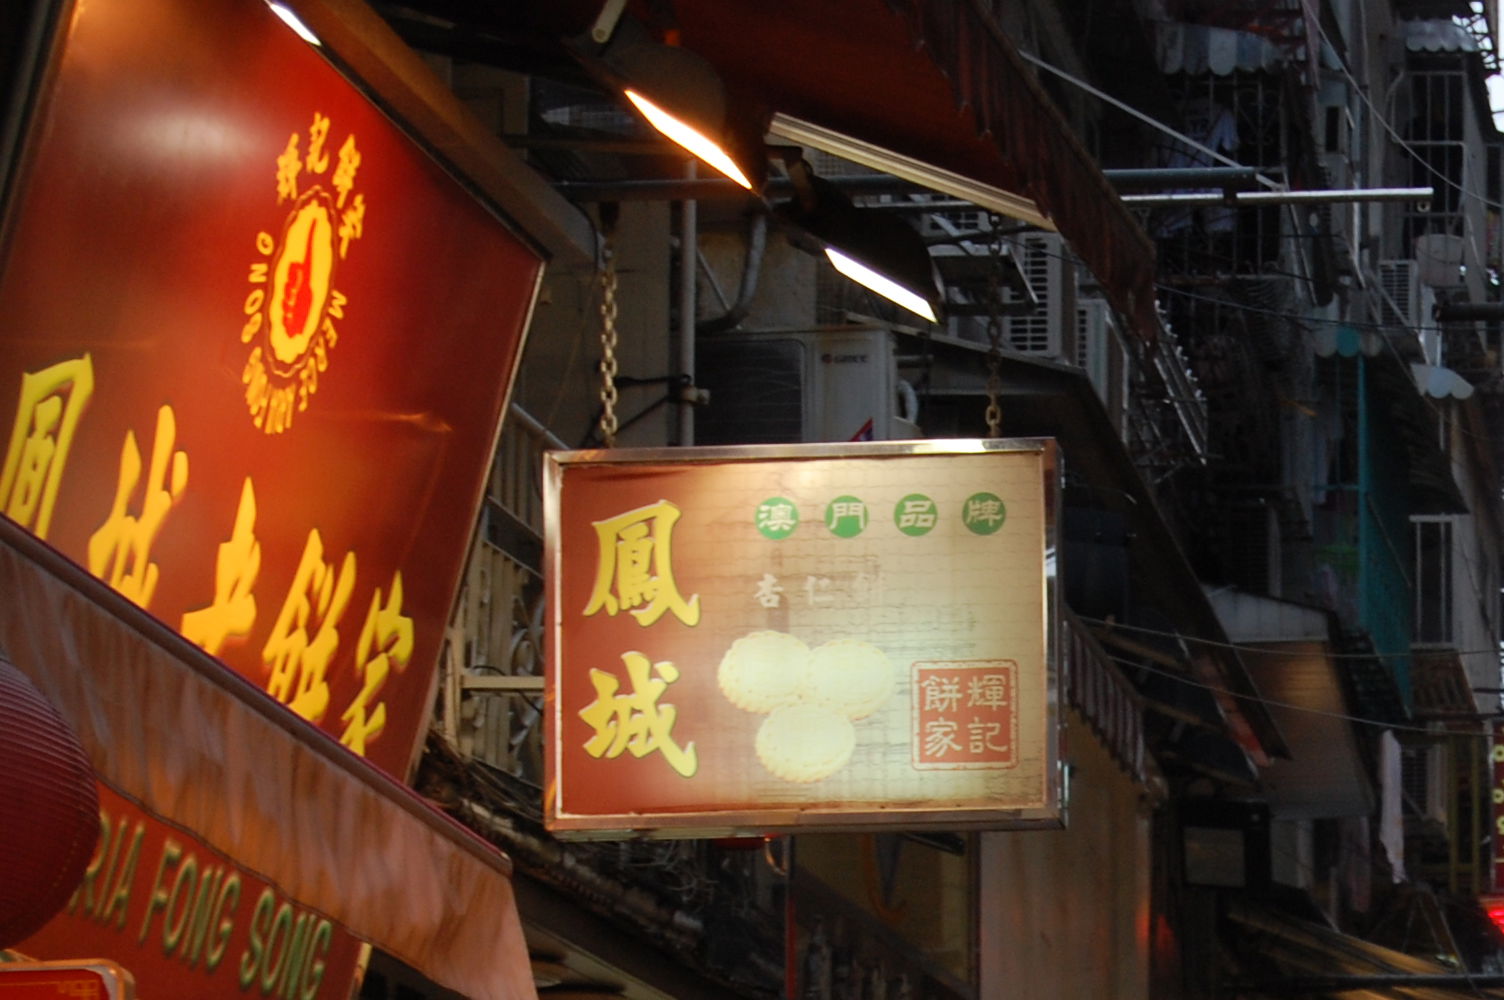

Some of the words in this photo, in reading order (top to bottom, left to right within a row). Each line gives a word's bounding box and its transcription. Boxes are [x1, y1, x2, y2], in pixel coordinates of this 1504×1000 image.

[758, 498, 1003, 532] 澳門品牌
[578, 498, 700, 778] 鳳城
[137, 837, 242, 975] FONG
